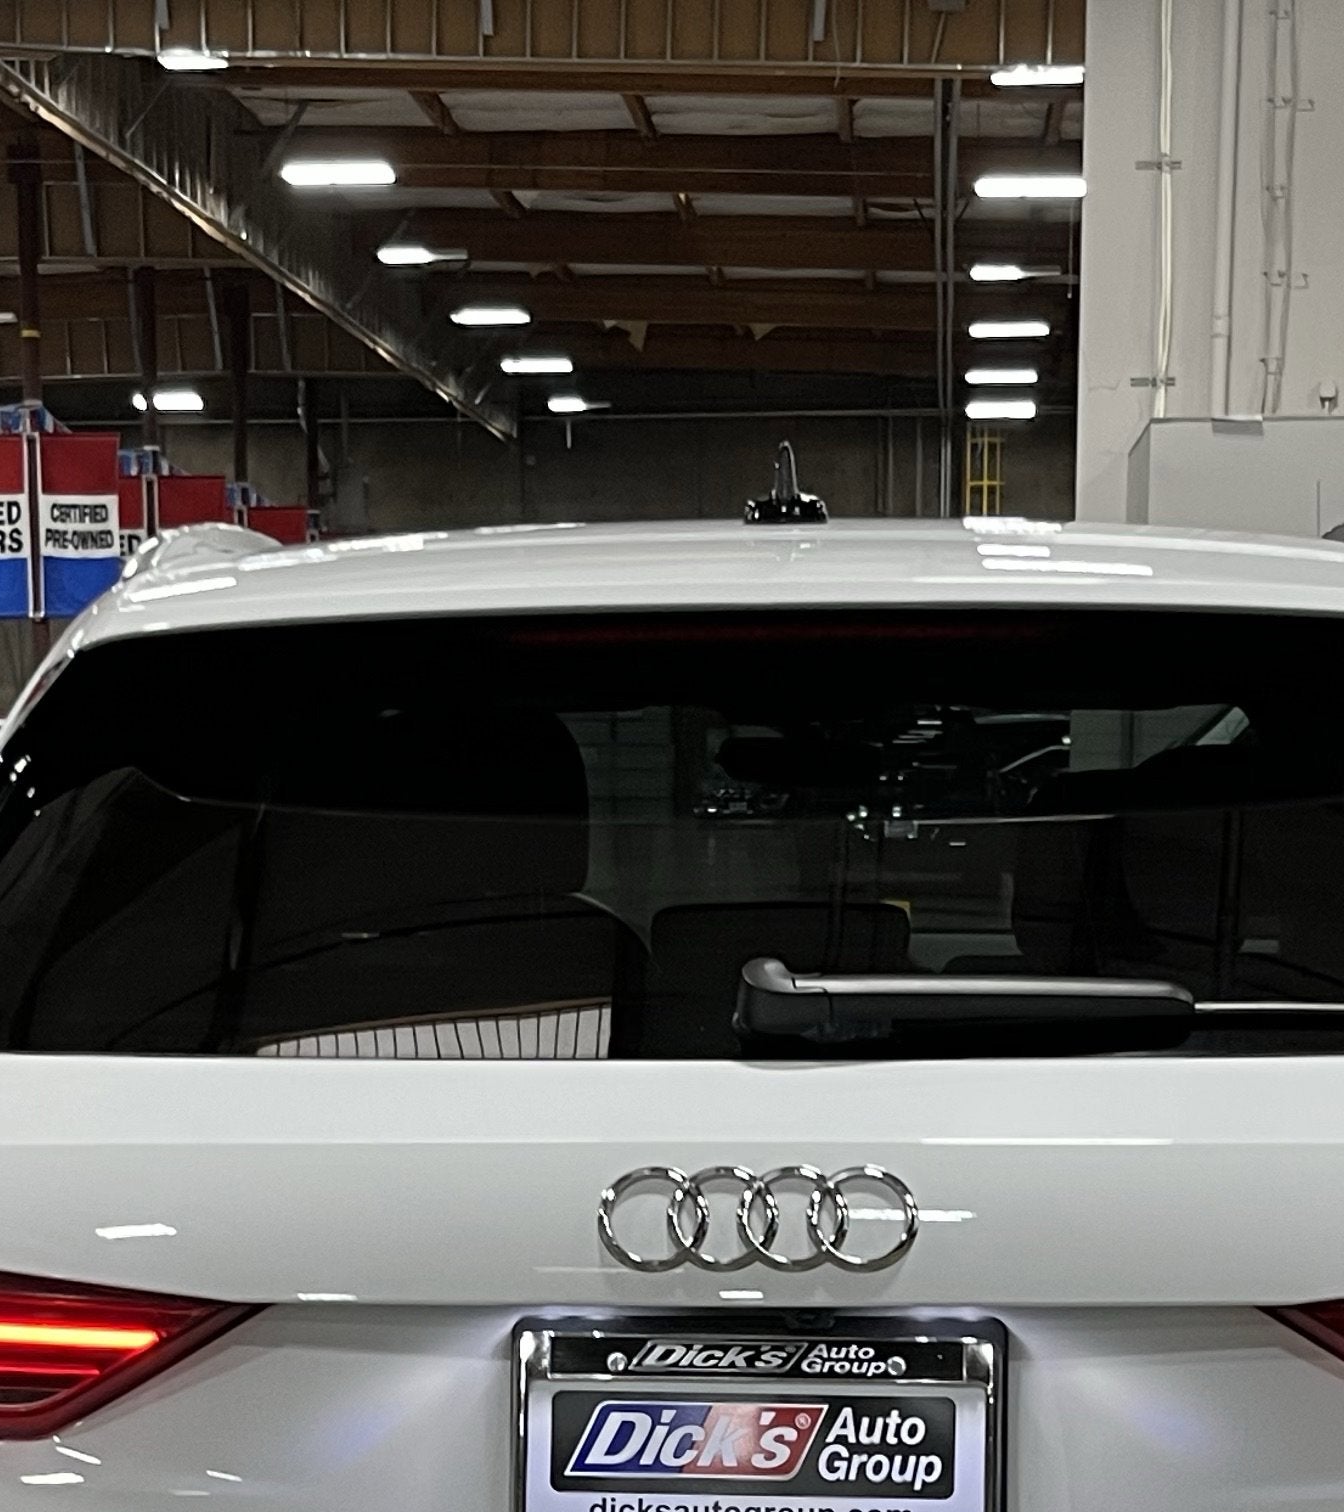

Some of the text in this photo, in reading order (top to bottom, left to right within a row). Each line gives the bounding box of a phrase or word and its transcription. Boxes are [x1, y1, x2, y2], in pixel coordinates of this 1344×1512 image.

[51, 502, 109, 524] CERTIFIED
[44, 528, 115, 550] PRE-OWNED
[642, 1342, 876, 1369] Dick's Auto
[800, 1357, 887, 1377] Group
[583, 1407, 926, 1469] Dick's Auto
[817, 1445, 943, 1490] Group
